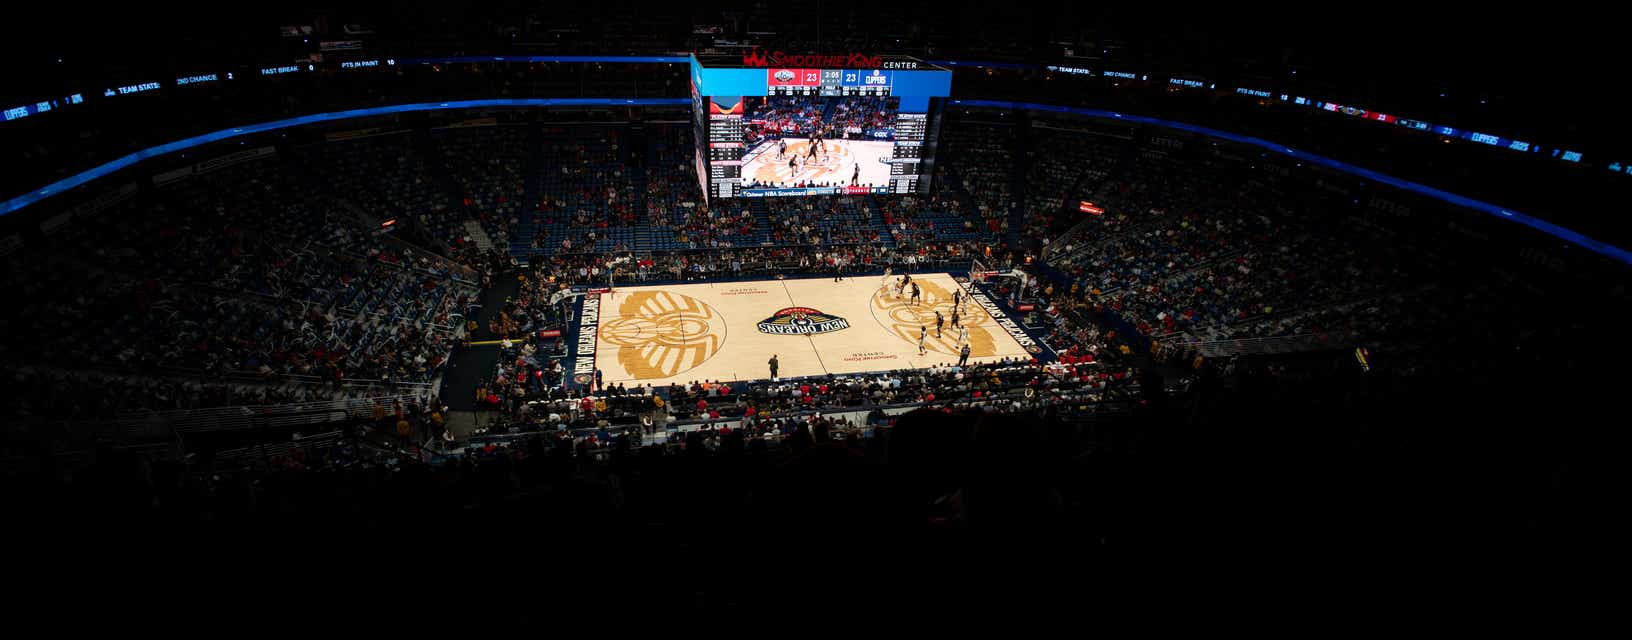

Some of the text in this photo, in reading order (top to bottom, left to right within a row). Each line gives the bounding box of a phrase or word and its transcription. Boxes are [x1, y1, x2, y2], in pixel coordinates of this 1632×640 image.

[772, 51, 843, 67] SMOOTHIE
[847, 52, 882, 68] KING
[189, 74, 217, 83] CHANCE
[806, 73, 817, 82] 23
[845, 73, 857, 82] 23
[118, 82, 161, 94] TEAM STATS:
[580, 299, 600, 325] PELICANS
[758, 318, 849, 334] NEW ORLEANS
[576, 326, 597, 355] ORLEANS
[574, 356, 595, 374] NEW
